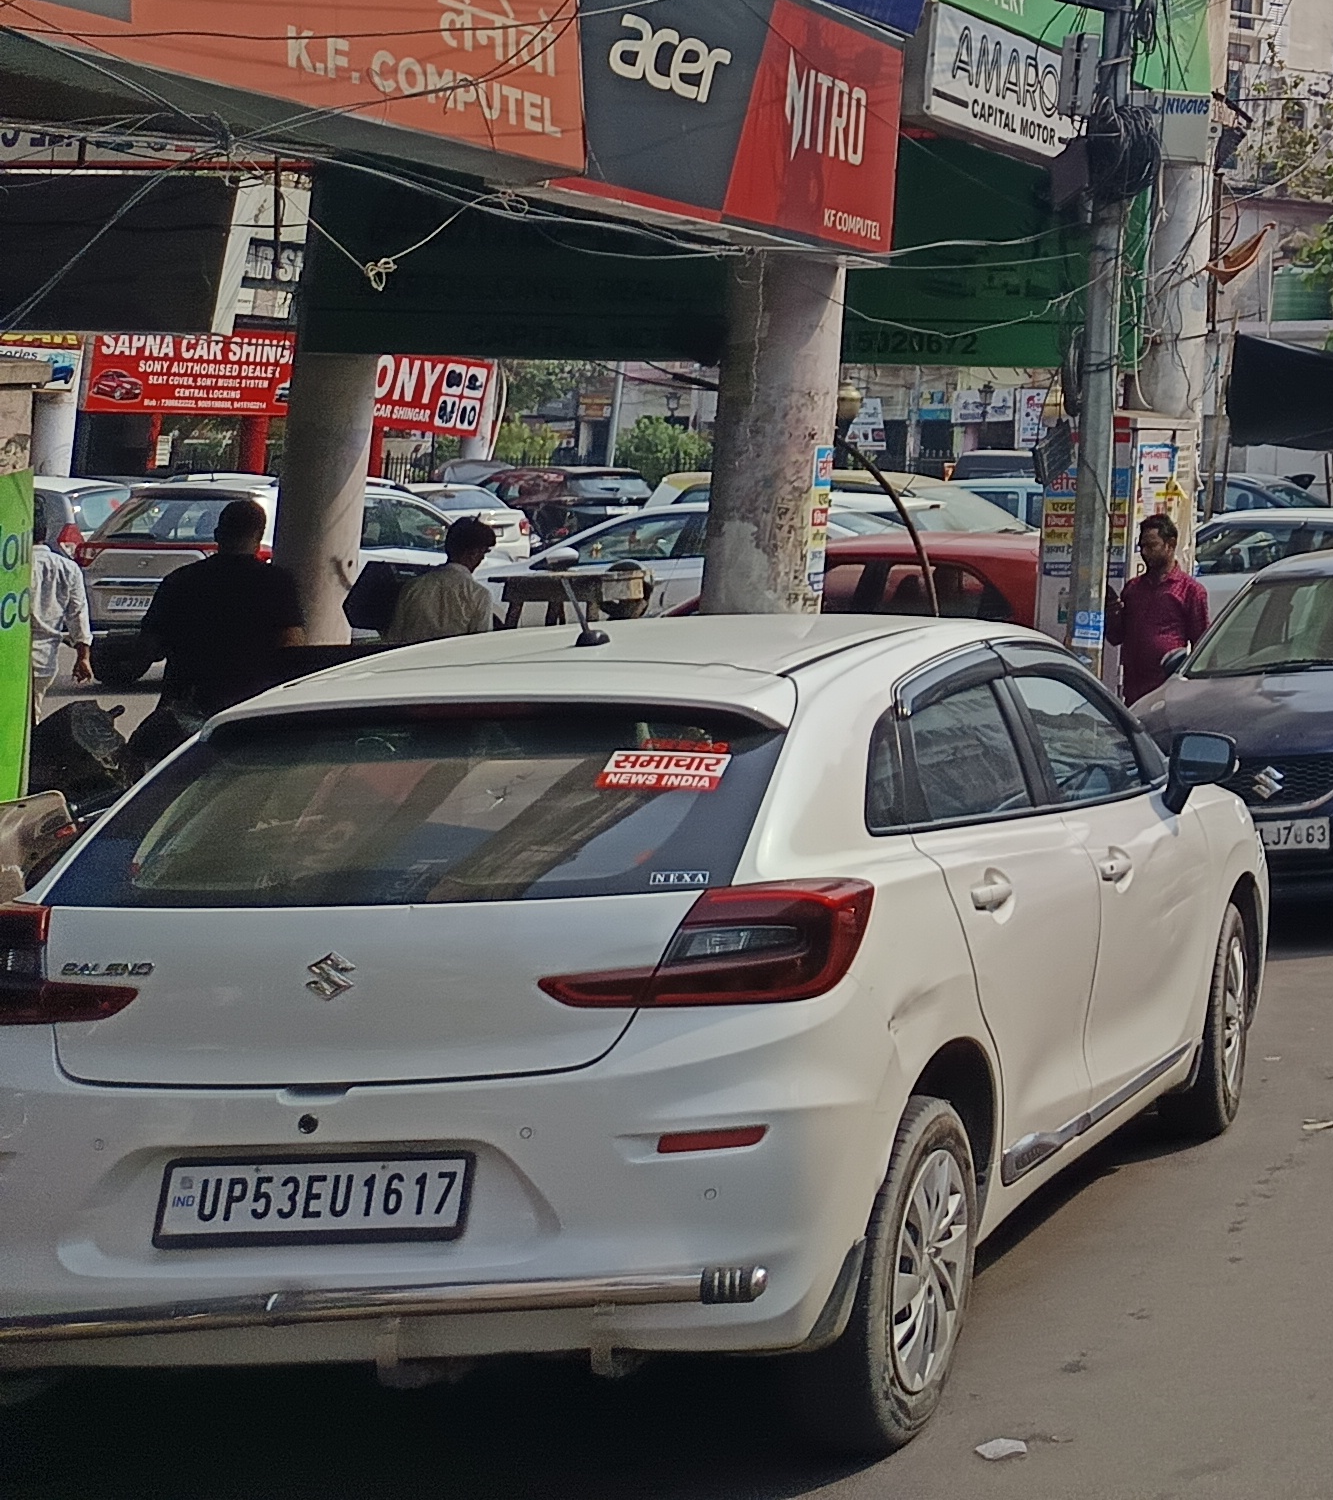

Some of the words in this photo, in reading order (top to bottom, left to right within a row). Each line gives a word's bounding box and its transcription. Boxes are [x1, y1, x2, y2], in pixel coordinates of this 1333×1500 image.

[608, 13, 732, 104] acer
[951, 25, 1065, 119] AMARO
[287, 24, 361, 85] K.F.
[367, 48, 563, 139] COMPUTEL
[786, 46, 868, 166] NITRO
[971, 99, 1016, 135] CAPITAL
[1019, 119, 1057, 147] MOTOR
[837, 211, 882, 242] COMPUTEL
[101, 334, 175, 357] SAPNA
[181, 334, 224, 361] CAR
[139, 360, 170, 374] SONY
[171, 362, 238, 377] AUTHORISED
[148, 375, 168, 385] SEAT
[375, 354, 445, 404] ONY
[174, 388, 207, 398] CENTRAL
[373, 403, 391, 417] CAR
[392, 405, 431, 423] SHINGAR
[614, 753, 727, 772] समाचार
[605, 773, 658, 786] NEWS
[661, 775, 710, 788] INDIA
[655, 873, 705, 883] NEXA
[172, 1194, 195, 1208] IND
[197, 1171, 459, 1222] UP53EU1617
